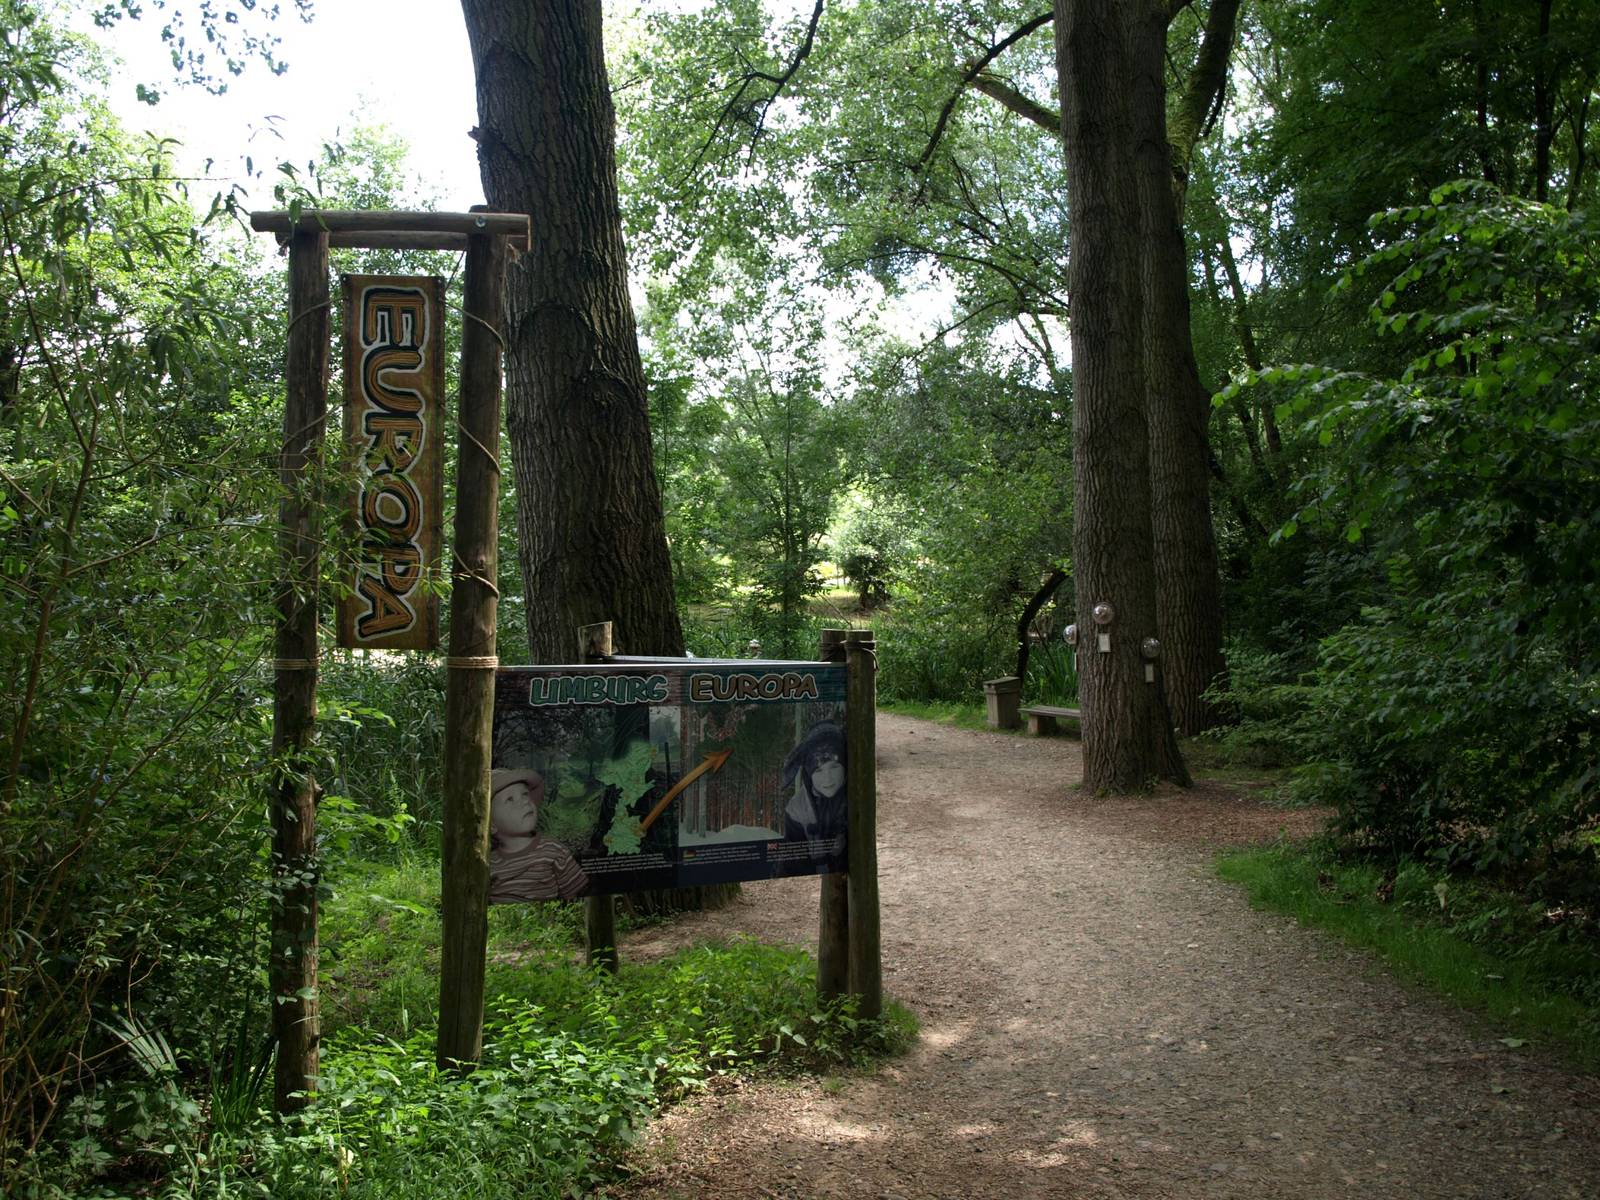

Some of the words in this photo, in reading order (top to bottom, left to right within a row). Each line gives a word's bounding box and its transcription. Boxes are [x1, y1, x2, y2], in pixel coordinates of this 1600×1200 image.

[355, 286, 430, 640] EUROPA
[529, 675, 669, 707] LIMBURG
[689, 672, 818, 703] EUROPA
